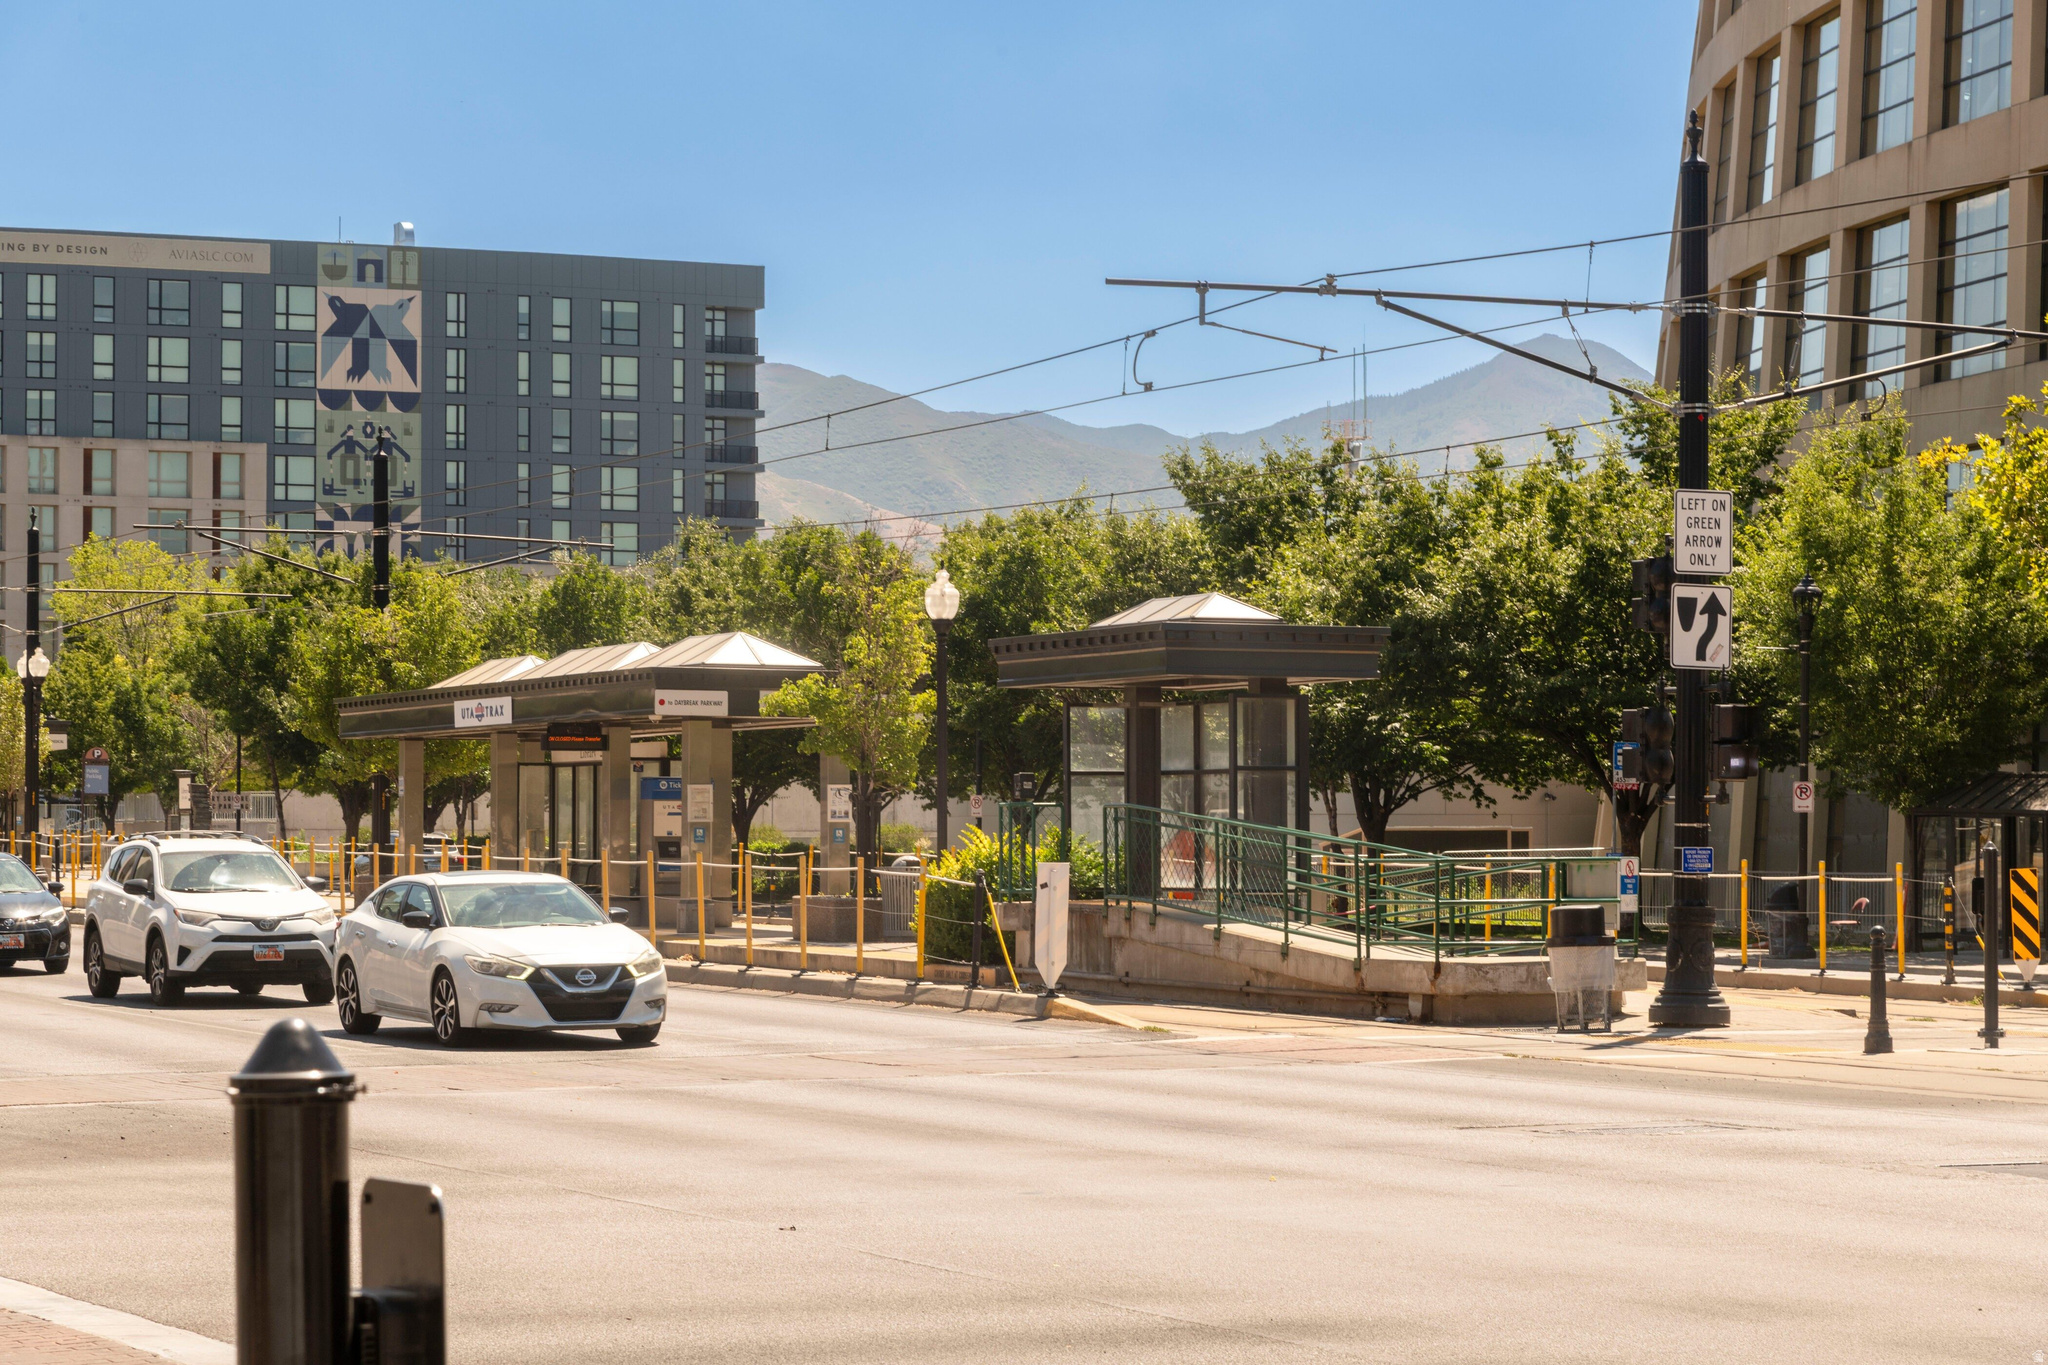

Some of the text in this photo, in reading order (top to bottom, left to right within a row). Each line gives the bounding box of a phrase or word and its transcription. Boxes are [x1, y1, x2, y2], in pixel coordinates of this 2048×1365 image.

[32, 244, 50, 253] BY
[56, 244, 108, 256] DESIGN
[168, 249, 254, 263] AVIASLC.COM
[1681, 498, 1726, 512] LEFT ON
[1686, 516, 1721, 530] GREEN
[1684, 535, 1722, 549] ARROW
[1689, 553, 1717, 567] ONLY
[461, 704, 504, 720] UTA TRAX
[93, 749, 102, 758] P
